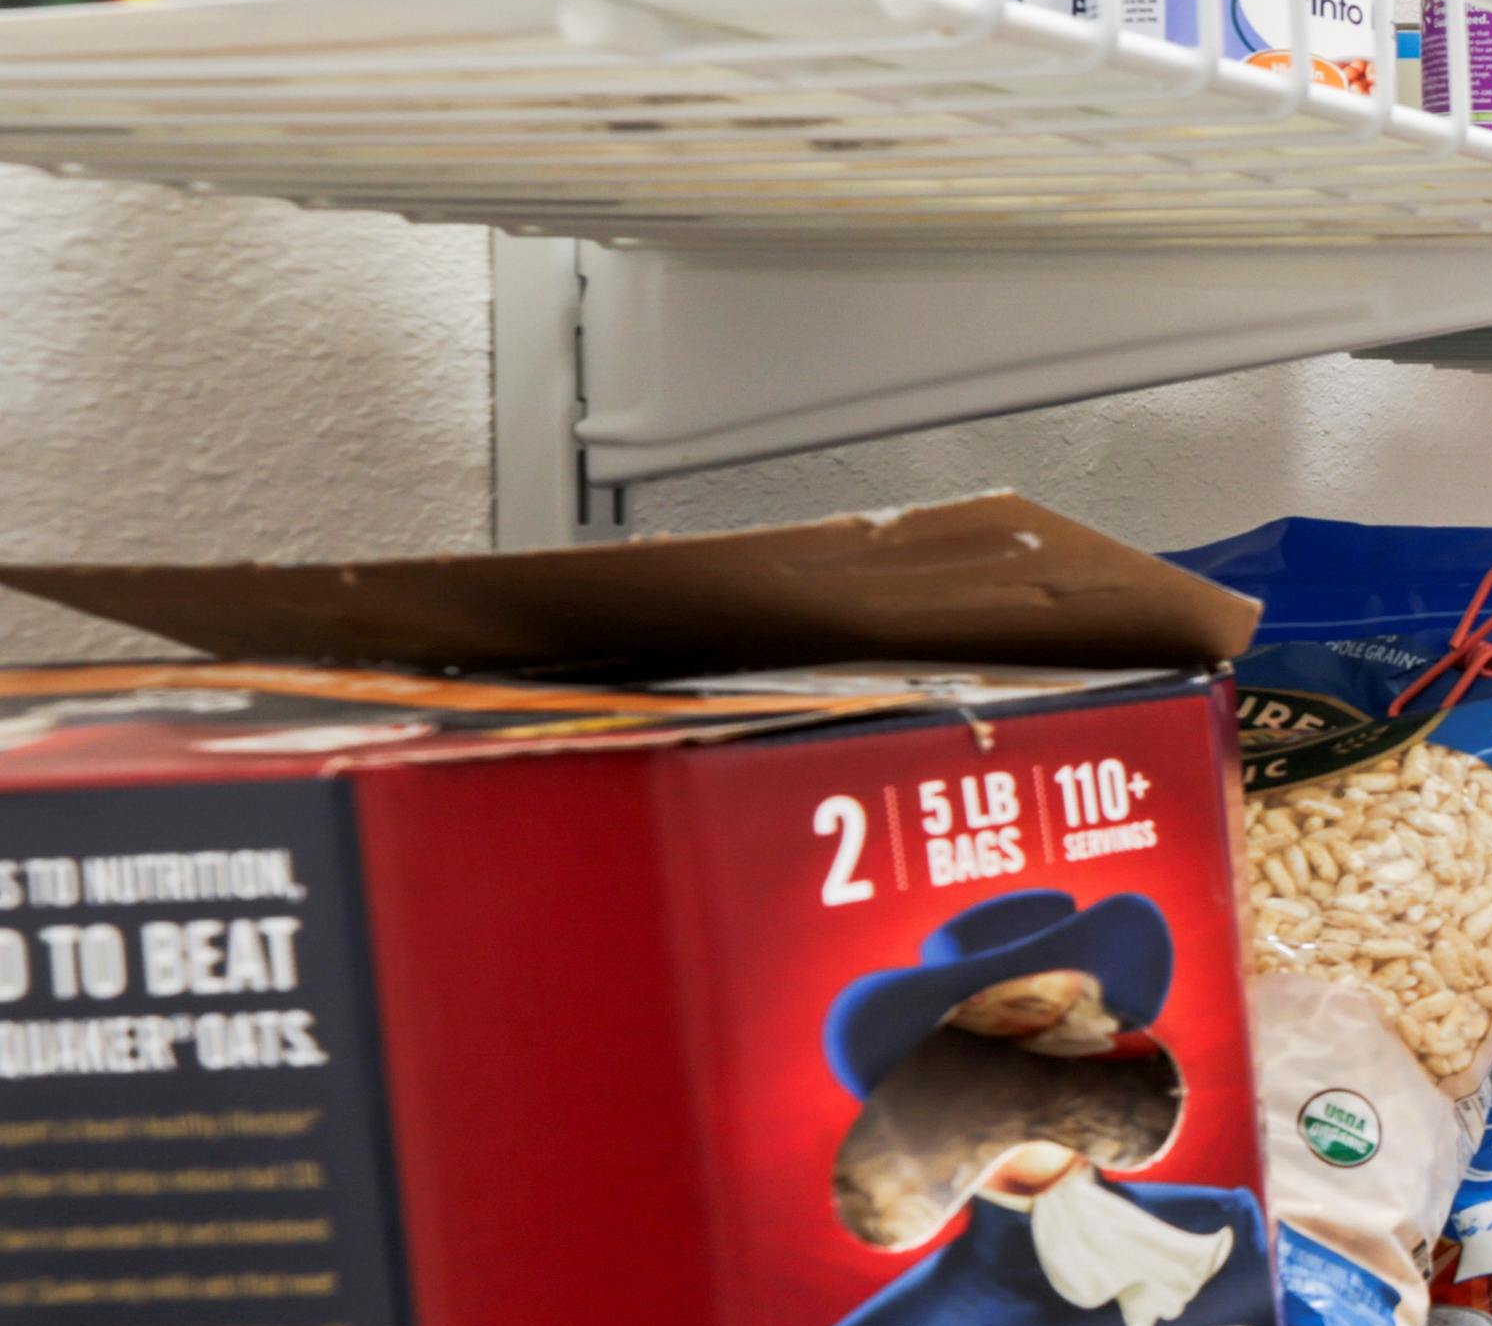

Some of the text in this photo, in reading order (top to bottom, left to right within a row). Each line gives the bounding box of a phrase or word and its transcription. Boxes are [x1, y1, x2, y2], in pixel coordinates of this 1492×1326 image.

[811, 757, 1152, 907] 2 5 LB 110+
[925, 818, 1158, 887] BAGS SERVINGS
[40, 917, 300, 999] TO BEAT
[1323, 1101, 1367, 1135] USDA
